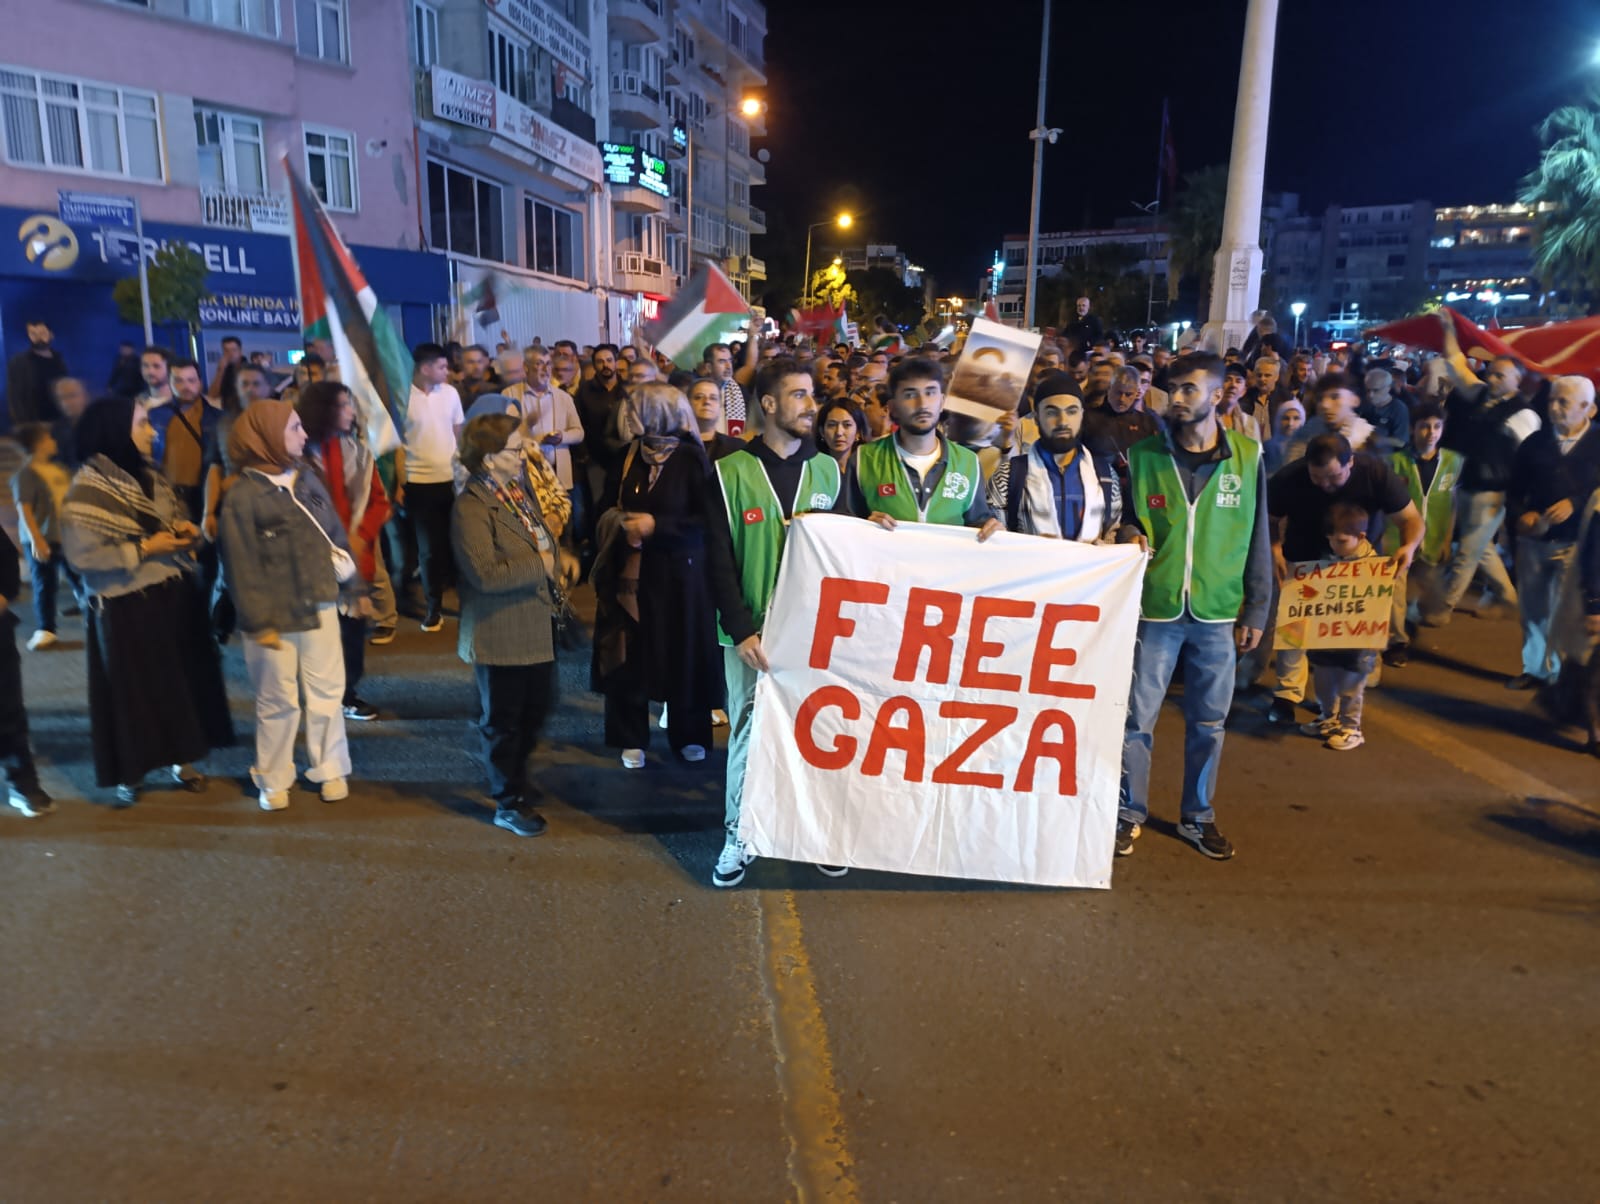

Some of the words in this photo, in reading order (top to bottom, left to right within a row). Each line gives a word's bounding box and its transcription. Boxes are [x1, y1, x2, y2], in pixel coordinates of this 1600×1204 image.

[1324, 584, 1393, 600] SELAM
[809, 576, 1101, 700] FREE
[1318, 620, 1388, 638] DEVAM
[794, 685, 1078, 797] GAZA
